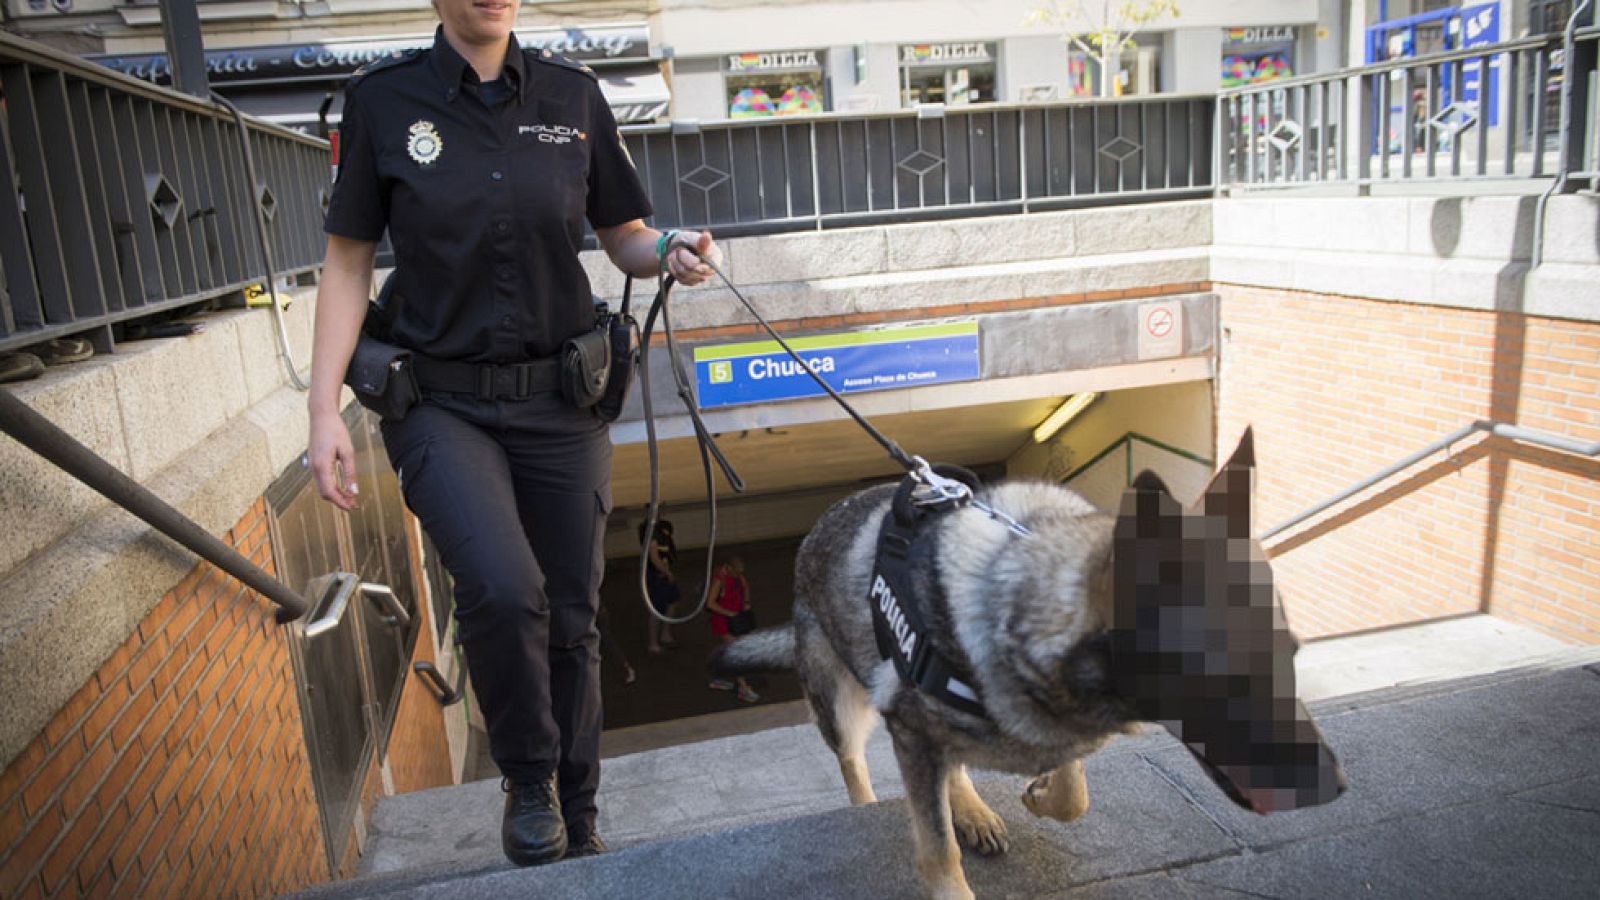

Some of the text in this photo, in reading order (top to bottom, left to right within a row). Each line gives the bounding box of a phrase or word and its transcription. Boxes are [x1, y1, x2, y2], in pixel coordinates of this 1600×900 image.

[714, 356, 836, 381] 5 Chueca
[907, 371, 937, 380] Chueca
[871, 574, 917, 663] POLICIA
